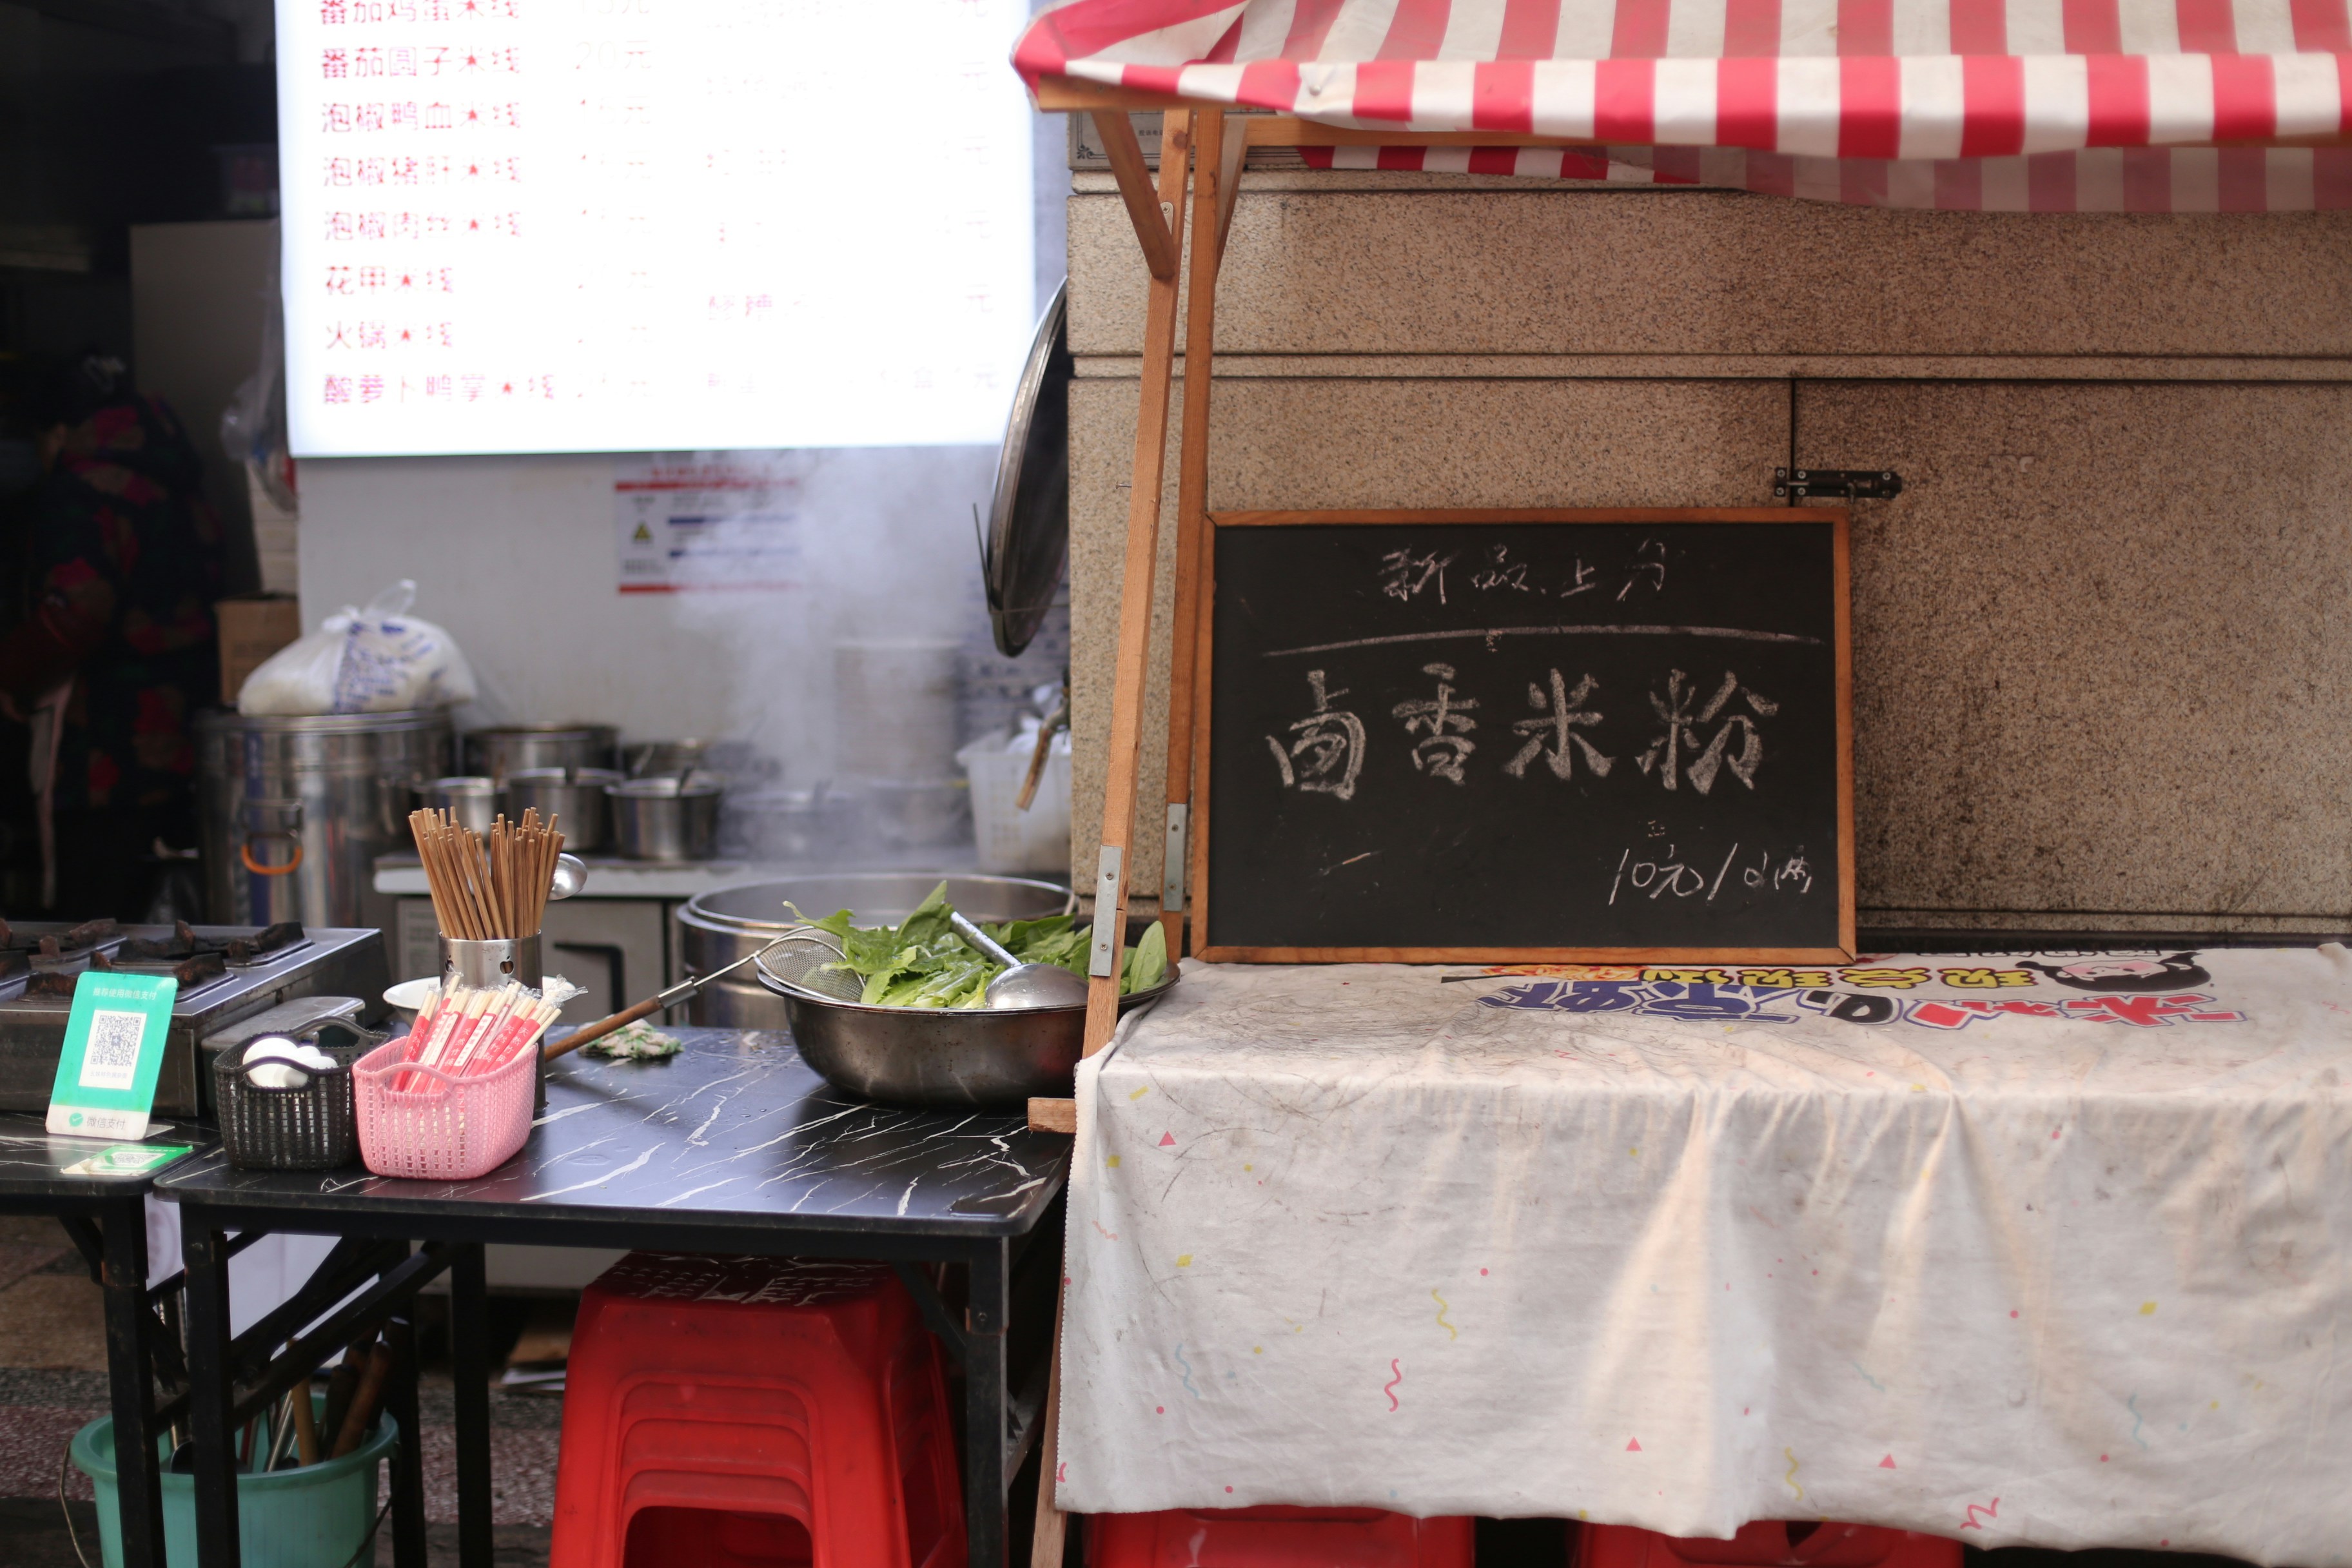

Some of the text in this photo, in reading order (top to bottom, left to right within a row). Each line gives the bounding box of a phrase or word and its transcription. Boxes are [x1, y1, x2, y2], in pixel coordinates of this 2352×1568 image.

[1265, 662, 1779, 801] 卤香米粉
[86, 1116, 126, 1130] 微信支付
